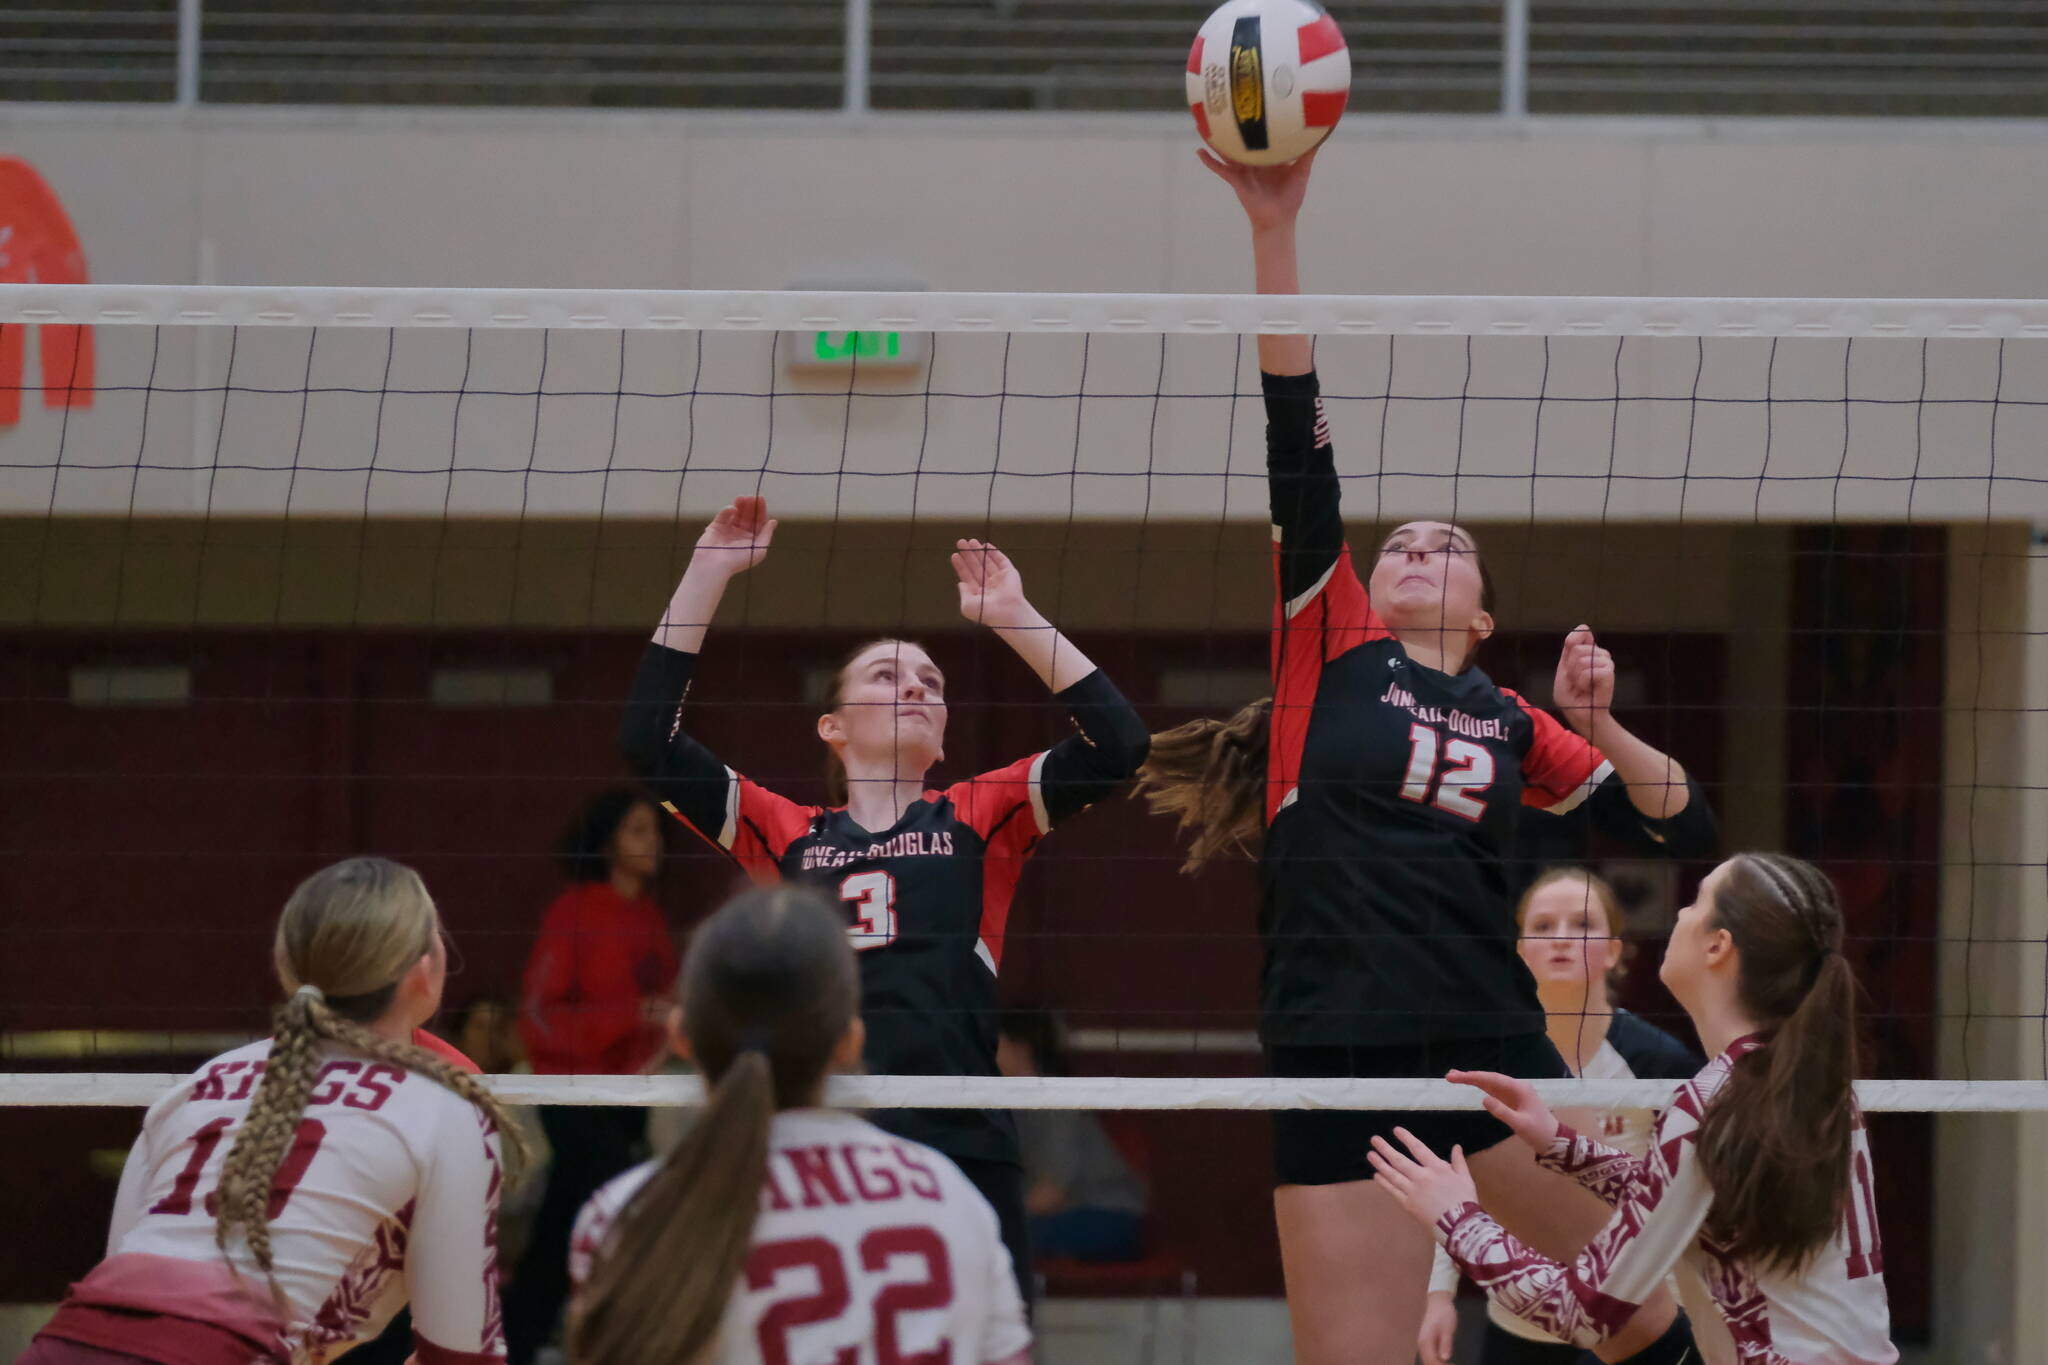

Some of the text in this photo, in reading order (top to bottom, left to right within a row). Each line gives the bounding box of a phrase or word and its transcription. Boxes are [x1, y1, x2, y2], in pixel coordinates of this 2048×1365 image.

[1399, 722, 1495, 823] 12
[840, 869, 899, 952] 3
[187, 1060, 407, 1111] KIGS
[742, 1223, 954, 1365] 22
